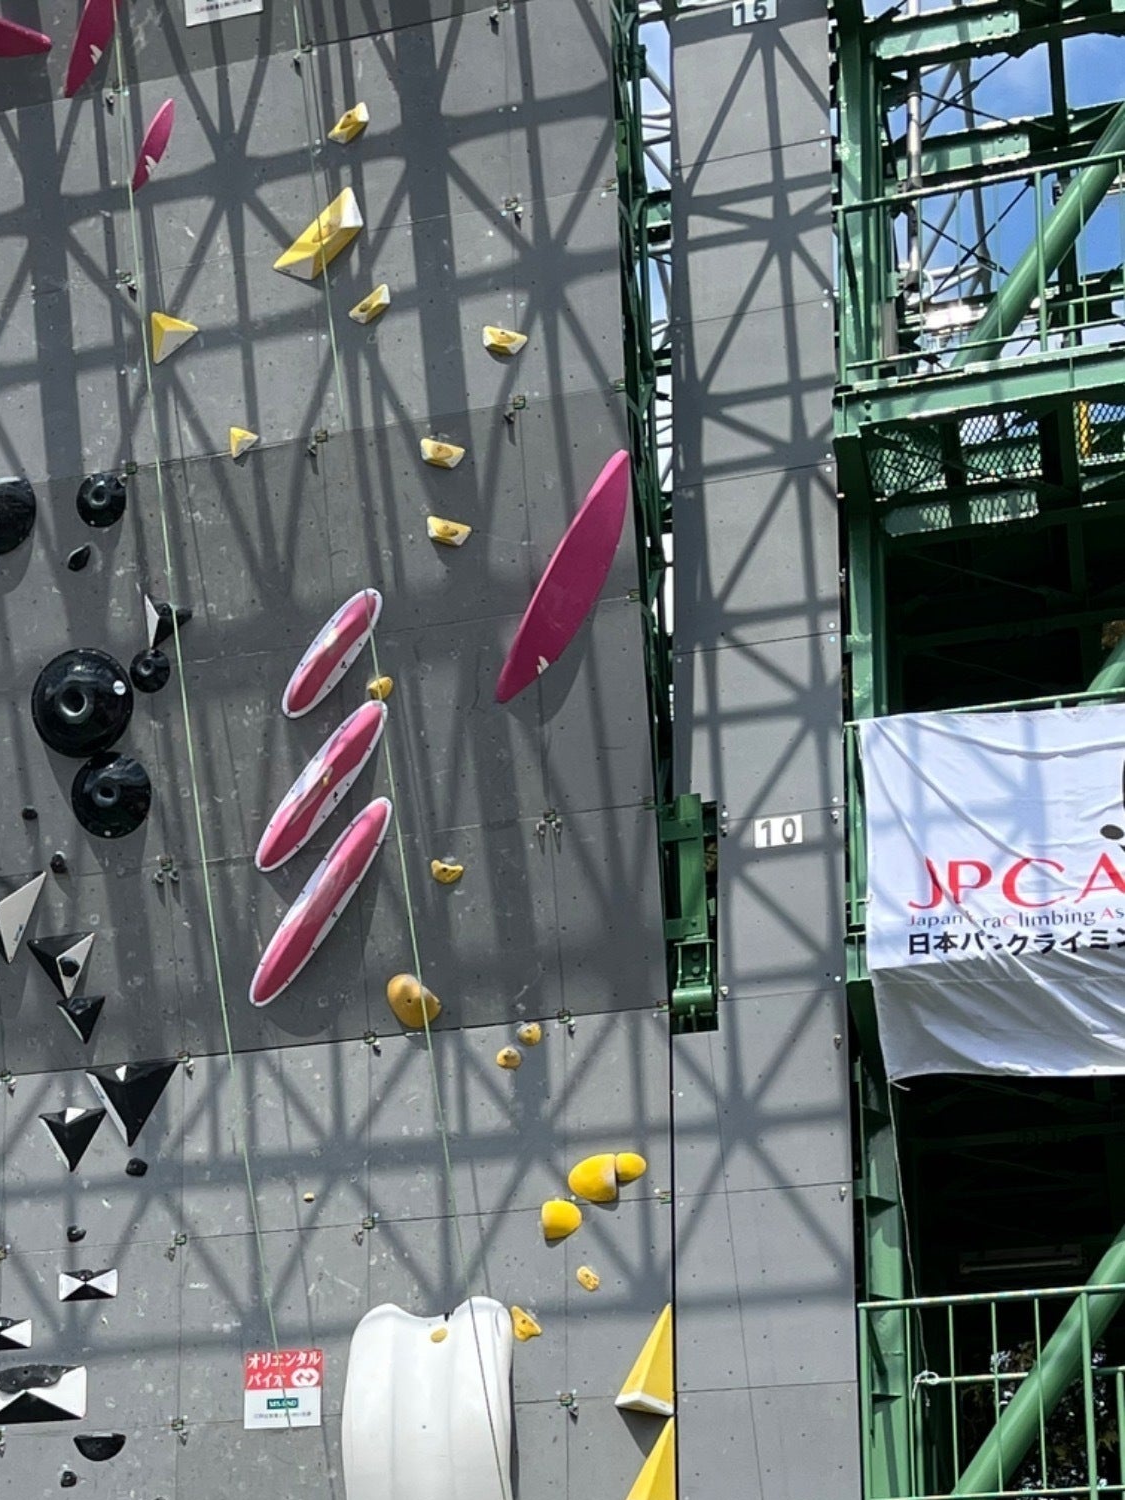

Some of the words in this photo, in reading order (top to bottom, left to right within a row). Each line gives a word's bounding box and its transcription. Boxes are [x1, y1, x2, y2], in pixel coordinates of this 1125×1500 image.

[735, 0, 766, 25] 15
[761, 818, 796, 846] 10
[907, 852, 1125, 909] JPCA
[247, 1351, 321, 1369] オリエンタル
